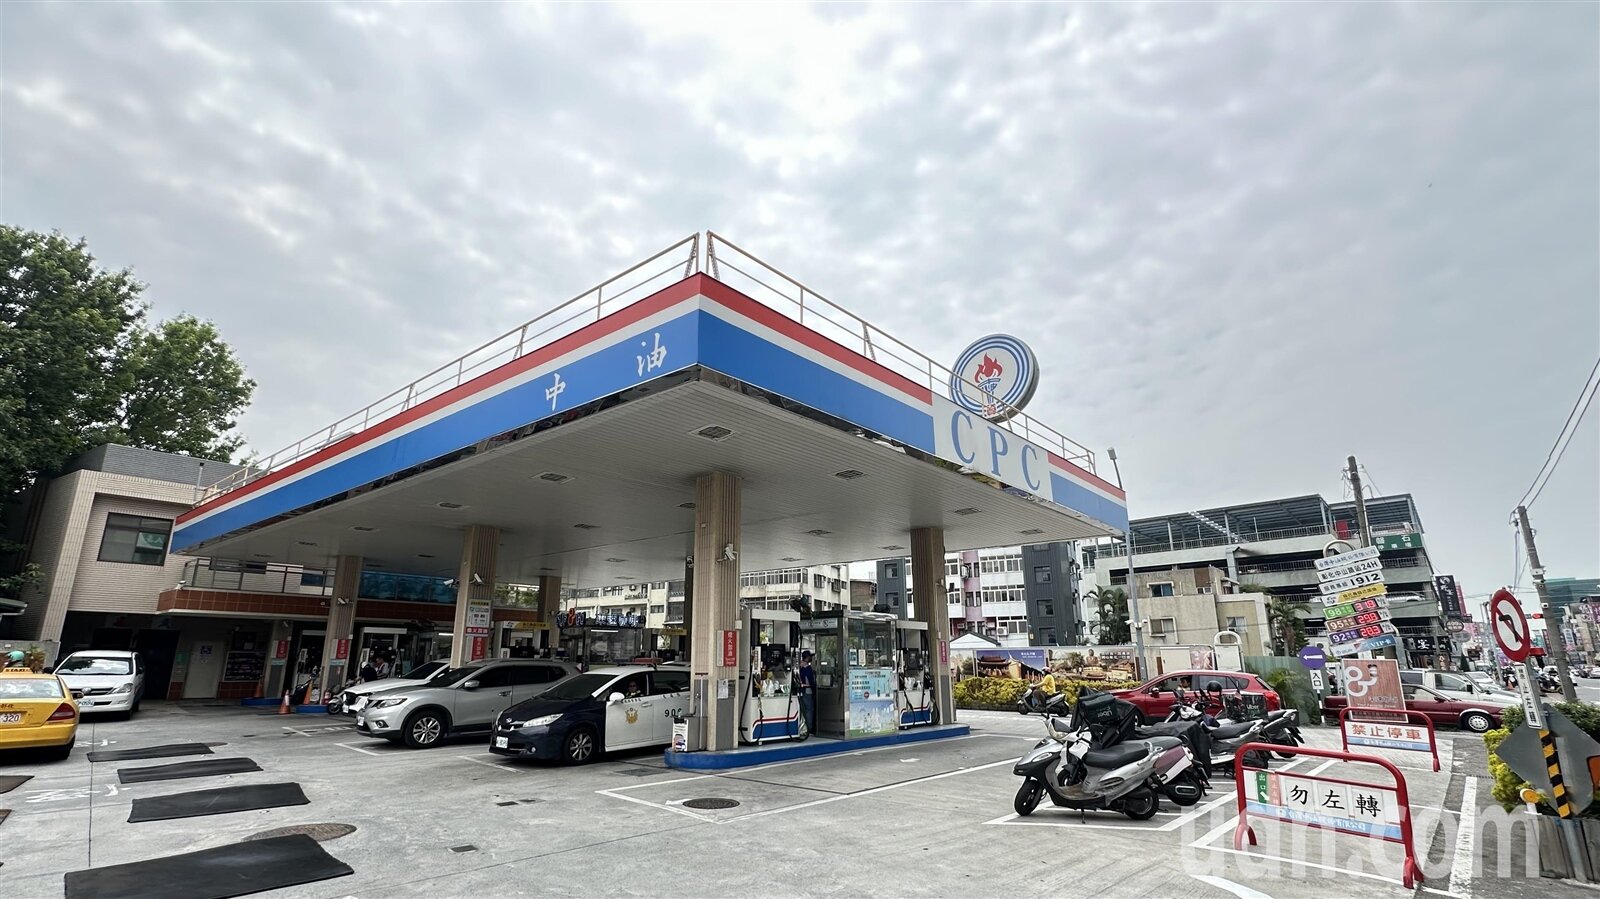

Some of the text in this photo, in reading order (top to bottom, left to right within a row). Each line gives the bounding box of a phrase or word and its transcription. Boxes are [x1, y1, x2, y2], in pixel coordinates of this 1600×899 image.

[545, 332, 667, 411] 中油
[952, 410, 1040, 491] CPC
[1350, 573, 1381, 586] 1912
[1328, 608, 1342, 617] 98
[1330, 620, 1344, 630] 95
[1332, 633, 1347, 643] 92
[1312, 672, 1322, 686] 入口
[1352, 724, 1422, 740] 禁止停車
[1258, 773, 1266, 790] 出口
[1290, 784, 1382, 818] 勿左轉
